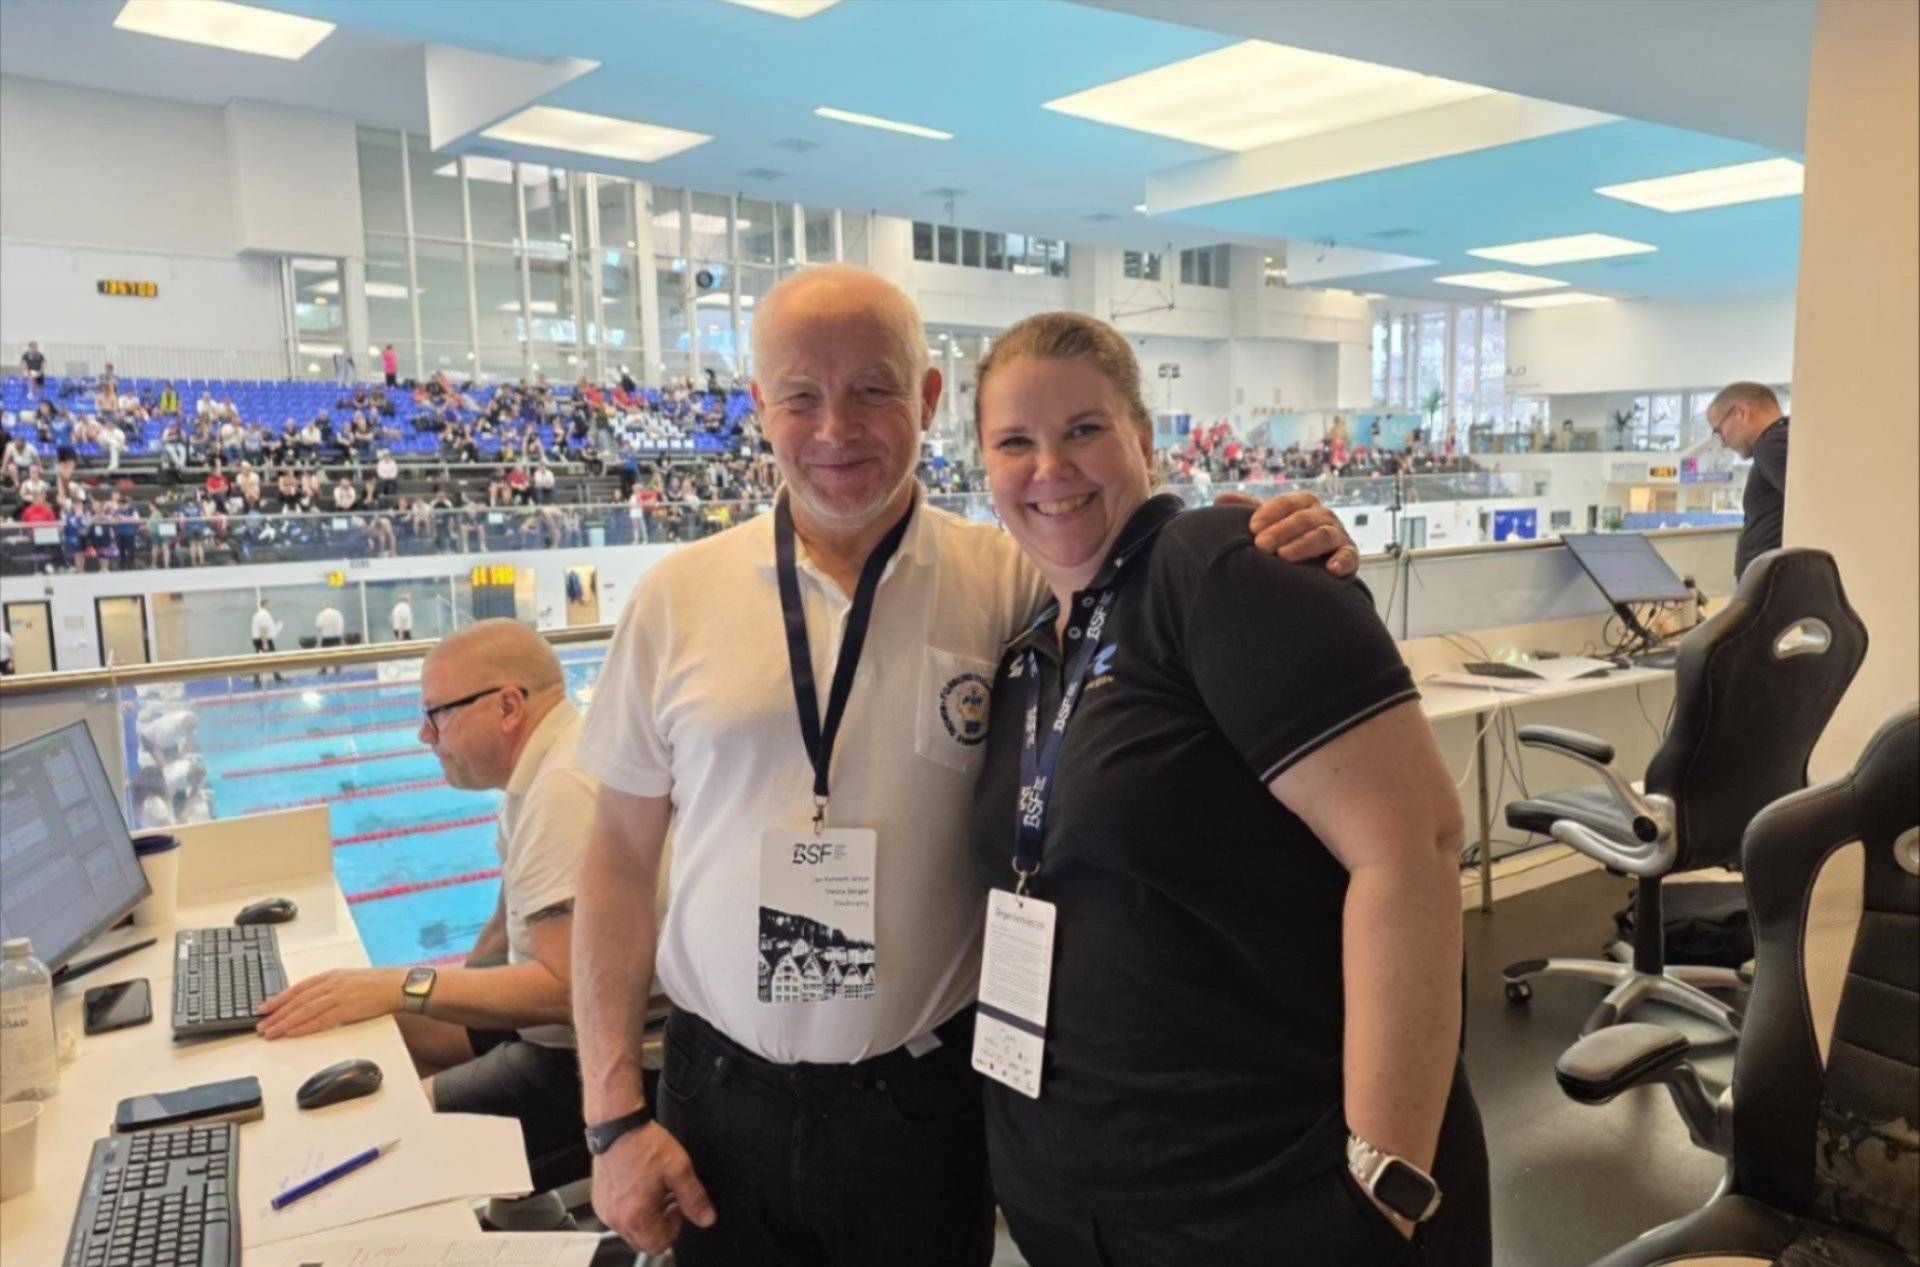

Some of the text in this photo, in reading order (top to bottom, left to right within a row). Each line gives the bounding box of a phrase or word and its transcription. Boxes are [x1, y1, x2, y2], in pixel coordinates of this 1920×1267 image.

[1086, 606, 1107, 641] BSF
[1023, 790, 1044, 829] BSF
[792, 843, 833, 865] BSF
